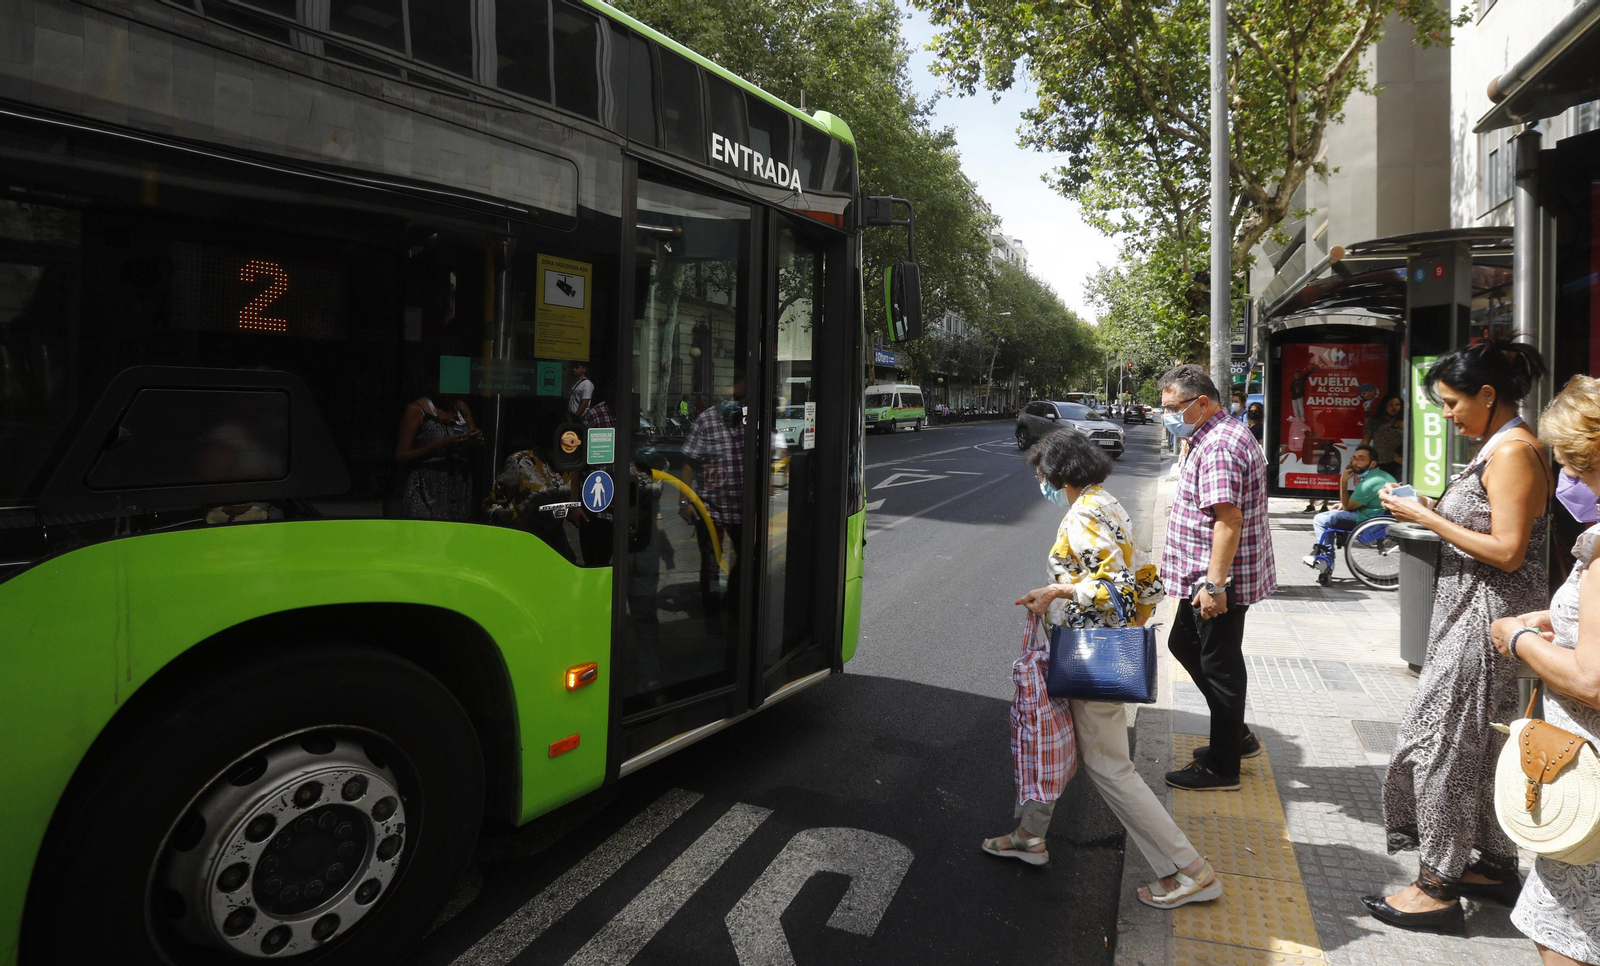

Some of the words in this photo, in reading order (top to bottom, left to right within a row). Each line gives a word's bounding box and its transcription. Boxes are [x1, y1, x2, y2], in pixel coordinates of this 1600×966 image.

[712, 132, 802, 194] ENTRADA
[541, 258, 555, 266] ZONA
[555, 261, 589, 273] VIDEOVIGILADA
[239, 260, 288, 332] 2
[494, 382, 502, 390] de
[1308, 376, 1360, 387] VUELTA
[1306, 396, 1360, 406] AHORRO
[1423, 413, 1442, 486] BUS
[1309, 477, 1317, 485] ES
